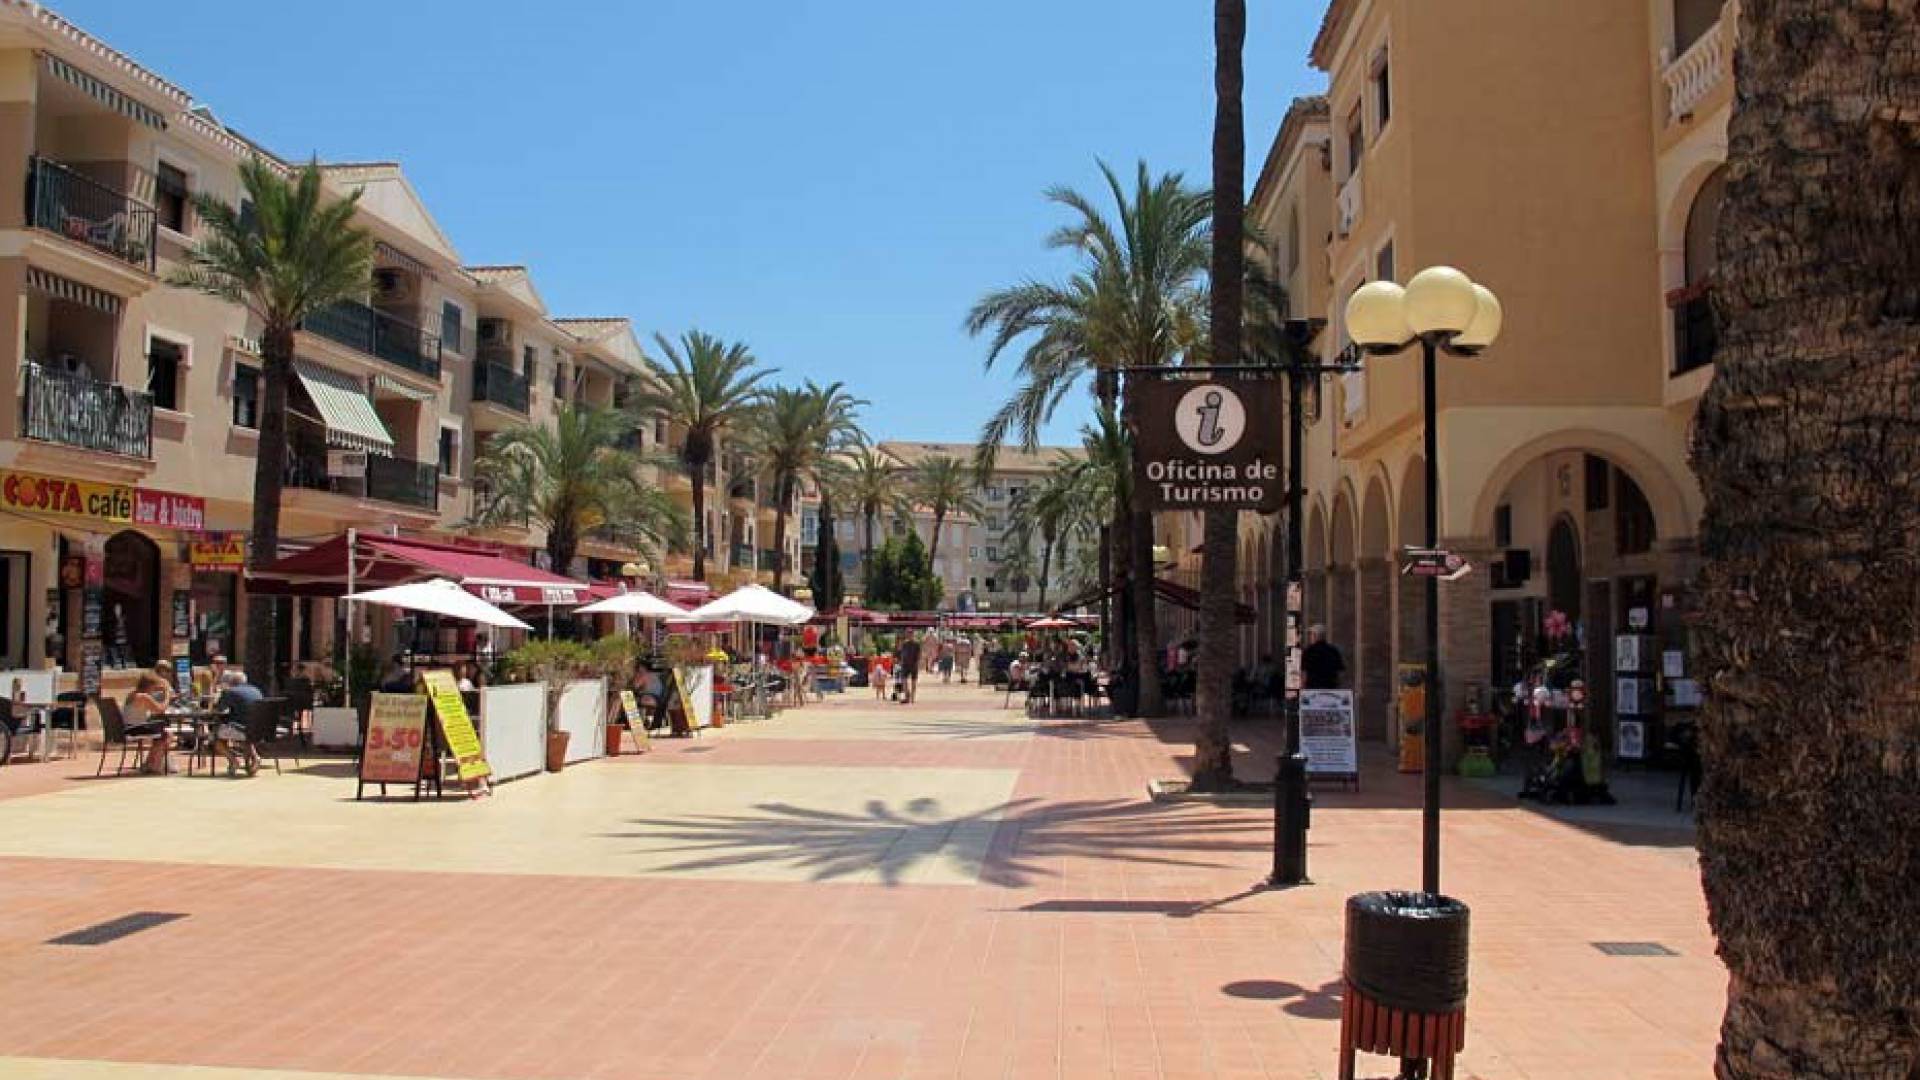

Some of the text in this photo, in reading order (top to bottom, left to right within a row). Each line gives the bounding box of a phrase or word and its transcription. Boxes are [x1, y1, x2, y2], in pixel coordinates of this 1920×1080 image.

[1146, 457, 1278, 481] Oficina de
[4, 474, 130, 519] COSTA café
[1159, 483, 1264, 502] Turismo
[368, 726, 421, 751] 3.50
